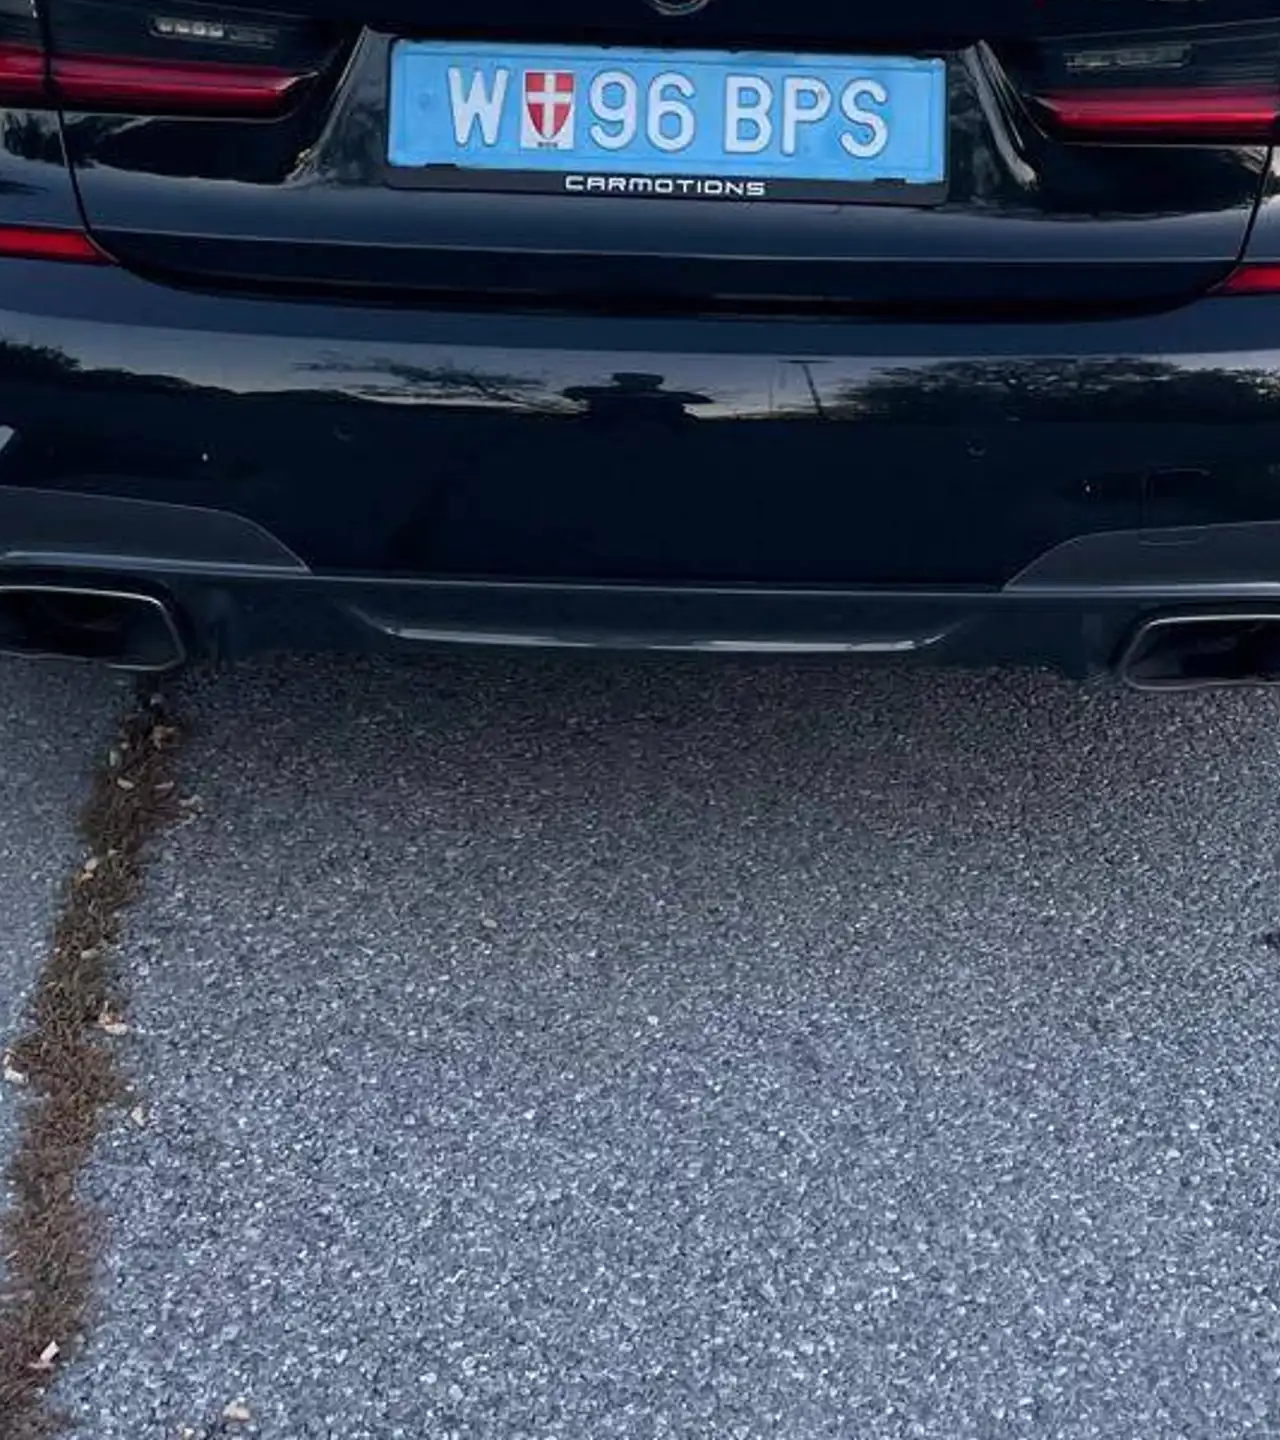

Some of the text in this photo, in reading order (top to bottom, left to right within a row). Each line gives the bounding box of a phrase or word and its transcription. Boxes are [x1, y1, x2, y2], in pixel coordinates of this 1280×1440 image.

[447, 67, 889, 159] W 96 BPS
[565, 175, 766, 196] CARMOTIONS
